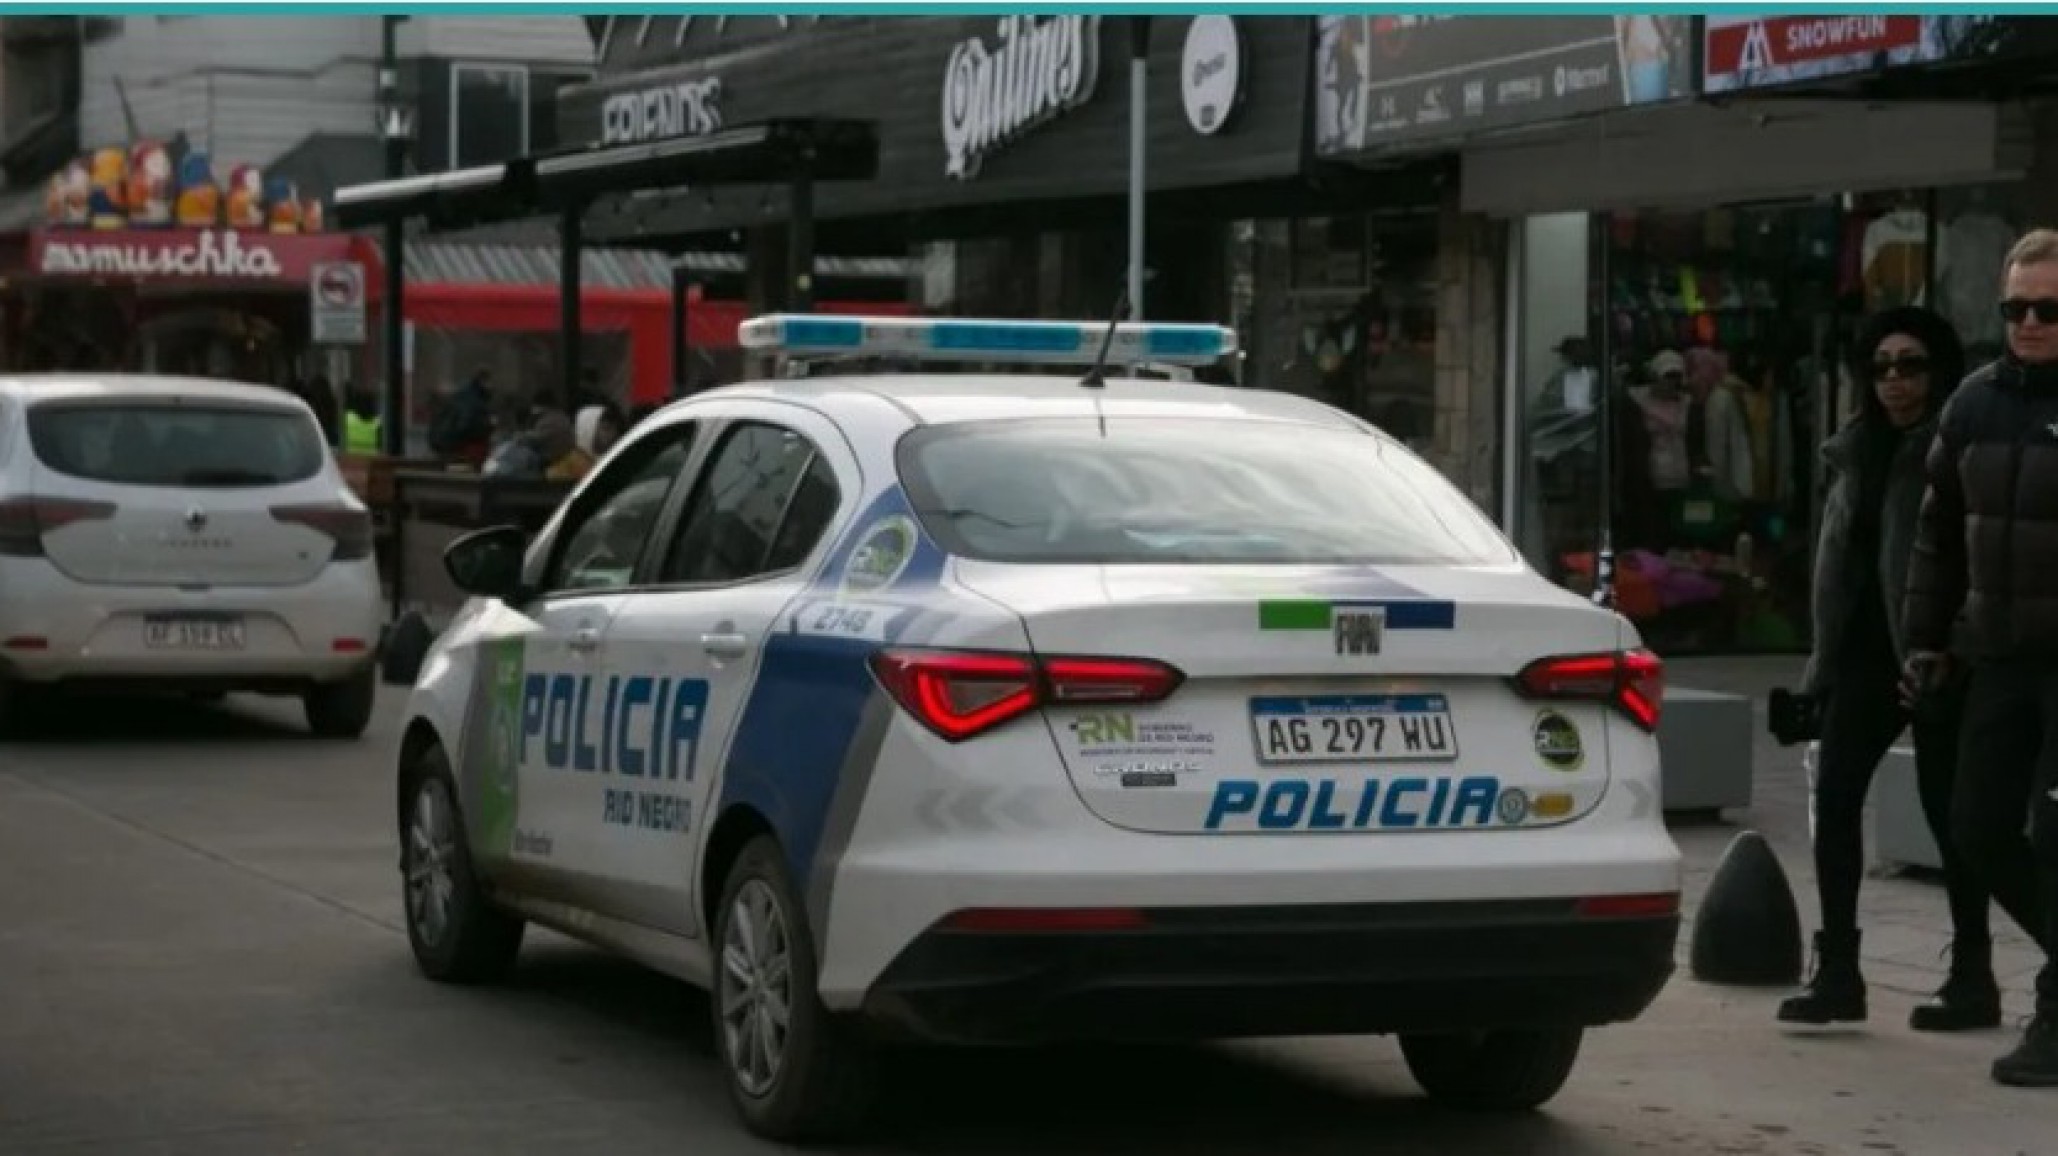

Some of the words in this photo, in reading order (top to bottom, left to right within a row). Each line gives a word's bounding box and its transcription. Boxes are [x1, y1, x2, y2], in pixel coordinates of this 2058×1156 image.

[1786, 15, 1885, 50] SNOWFUN
[520, 672, 711, 781] POLICIA
[1077, 712, 1134, 745] RN
[1269, 718, 1312, 754] AG
[1322, 717, 1385, 753] 297
[1400, 716, 1447, 751] WU
[603, 788, 634, 827] RIO
[638, 793, 692, 834] NEGRO
[1205, 778, 1499, 829] POLICIA
